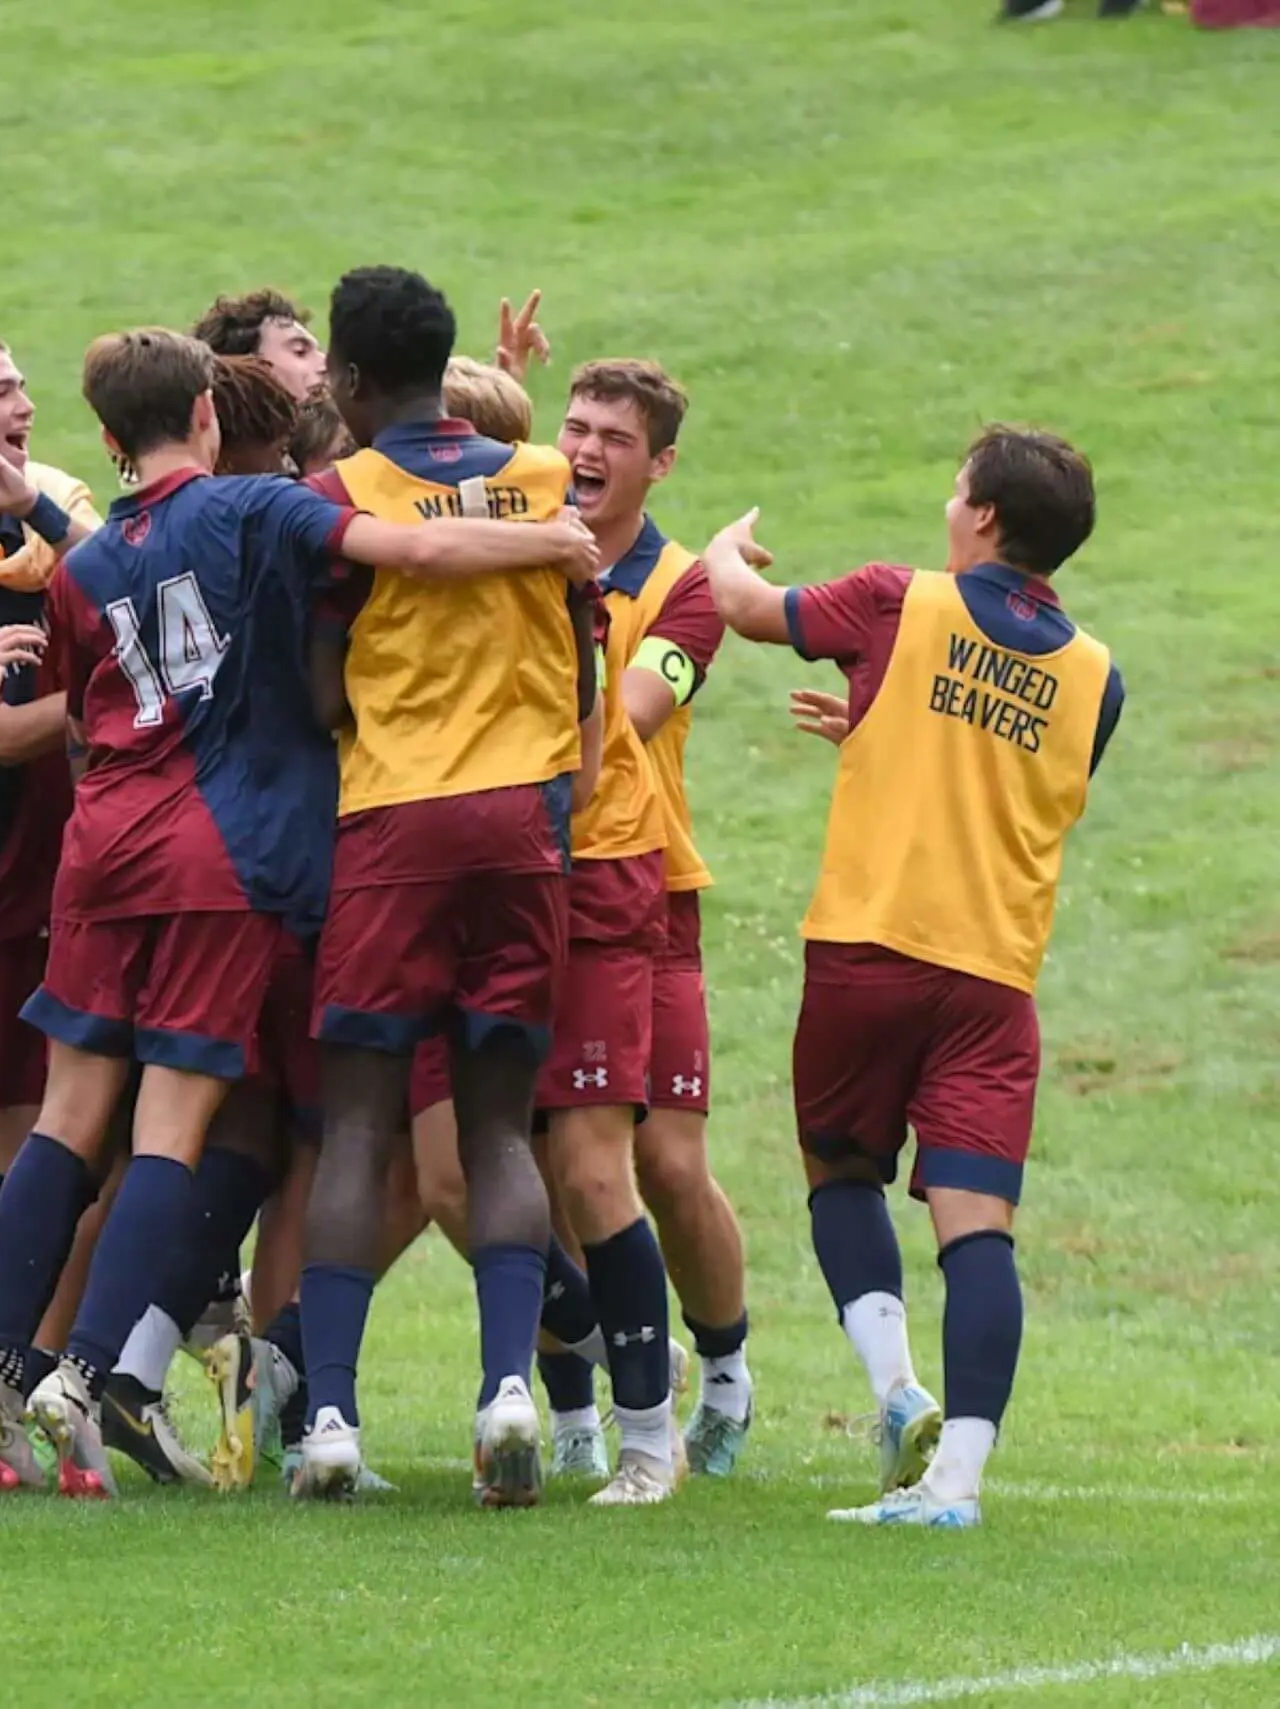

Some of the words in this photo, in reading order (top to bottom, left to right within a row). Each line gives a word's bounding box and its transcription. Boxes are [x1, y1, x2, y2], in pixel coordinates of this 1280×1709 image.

[414, 486, 528, 520] WIED
[106, 570, 232, 731] 14
[661, 650, 685, 683] C
[949, 633, 1059, 711] WINGED
[929, 675, 1049, 753] BEAVERS
